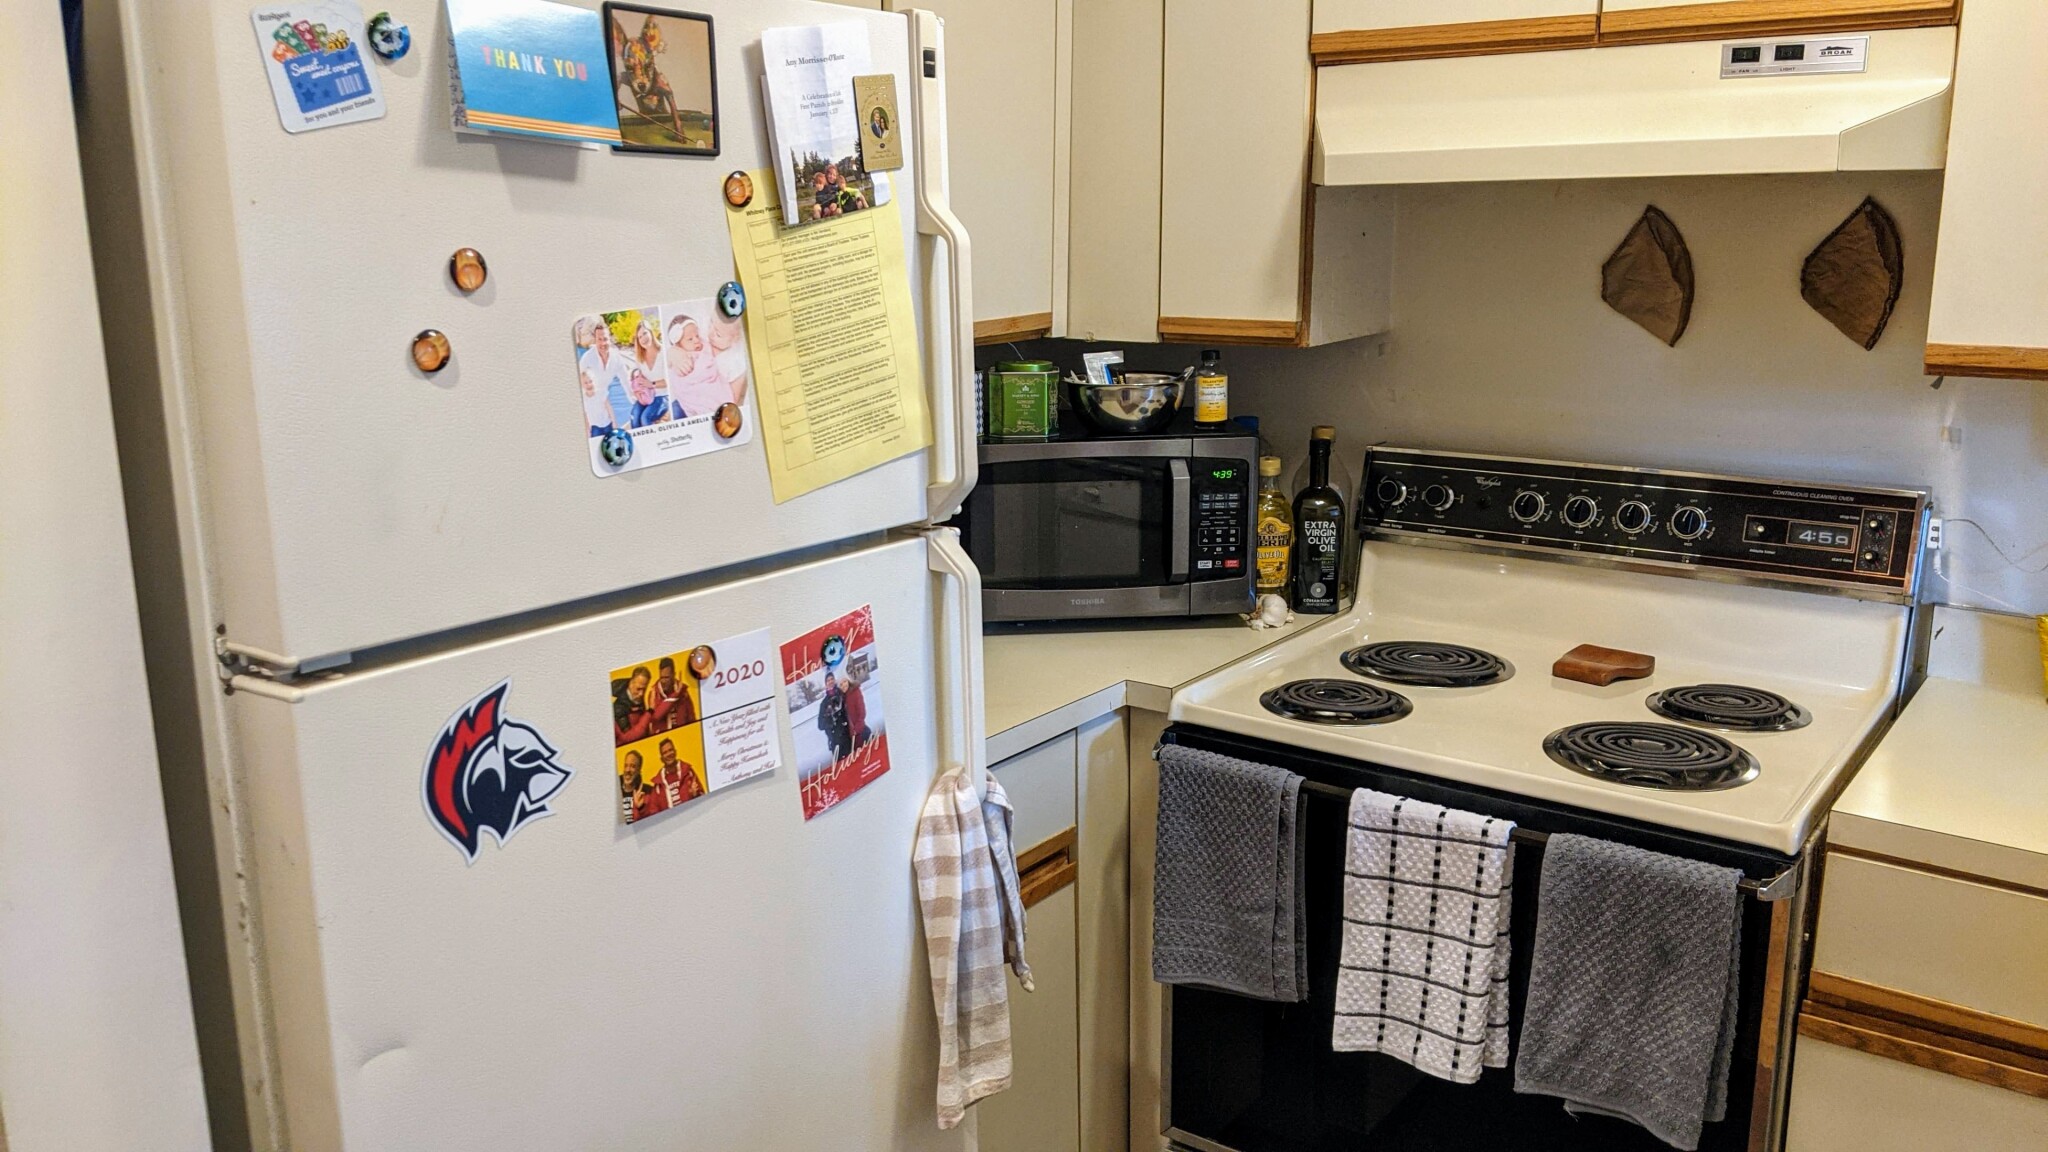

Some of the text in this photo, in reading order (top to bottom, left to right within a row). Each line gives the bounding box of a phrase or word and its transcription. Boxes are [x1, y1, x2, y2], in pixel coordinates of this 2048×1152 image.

[481, 44, 588, 82] THANK YOU
[328, 107, 340, 116] and
[340, 104, 354, 114] your
[632, 428, 656, 437] ANDRA,
[658, 424, 679, 432] OLIVIA
[687, 416, 710, 426] AMELIA
[1213, 470, 1232, 478] 4:39
[1772, 490, 1809, 498] CONTINUOUS
[786, 626, 860, 688] Hay
[714, 660, 764, 689] 2020
[802, 726, 881, 807] Holidays
